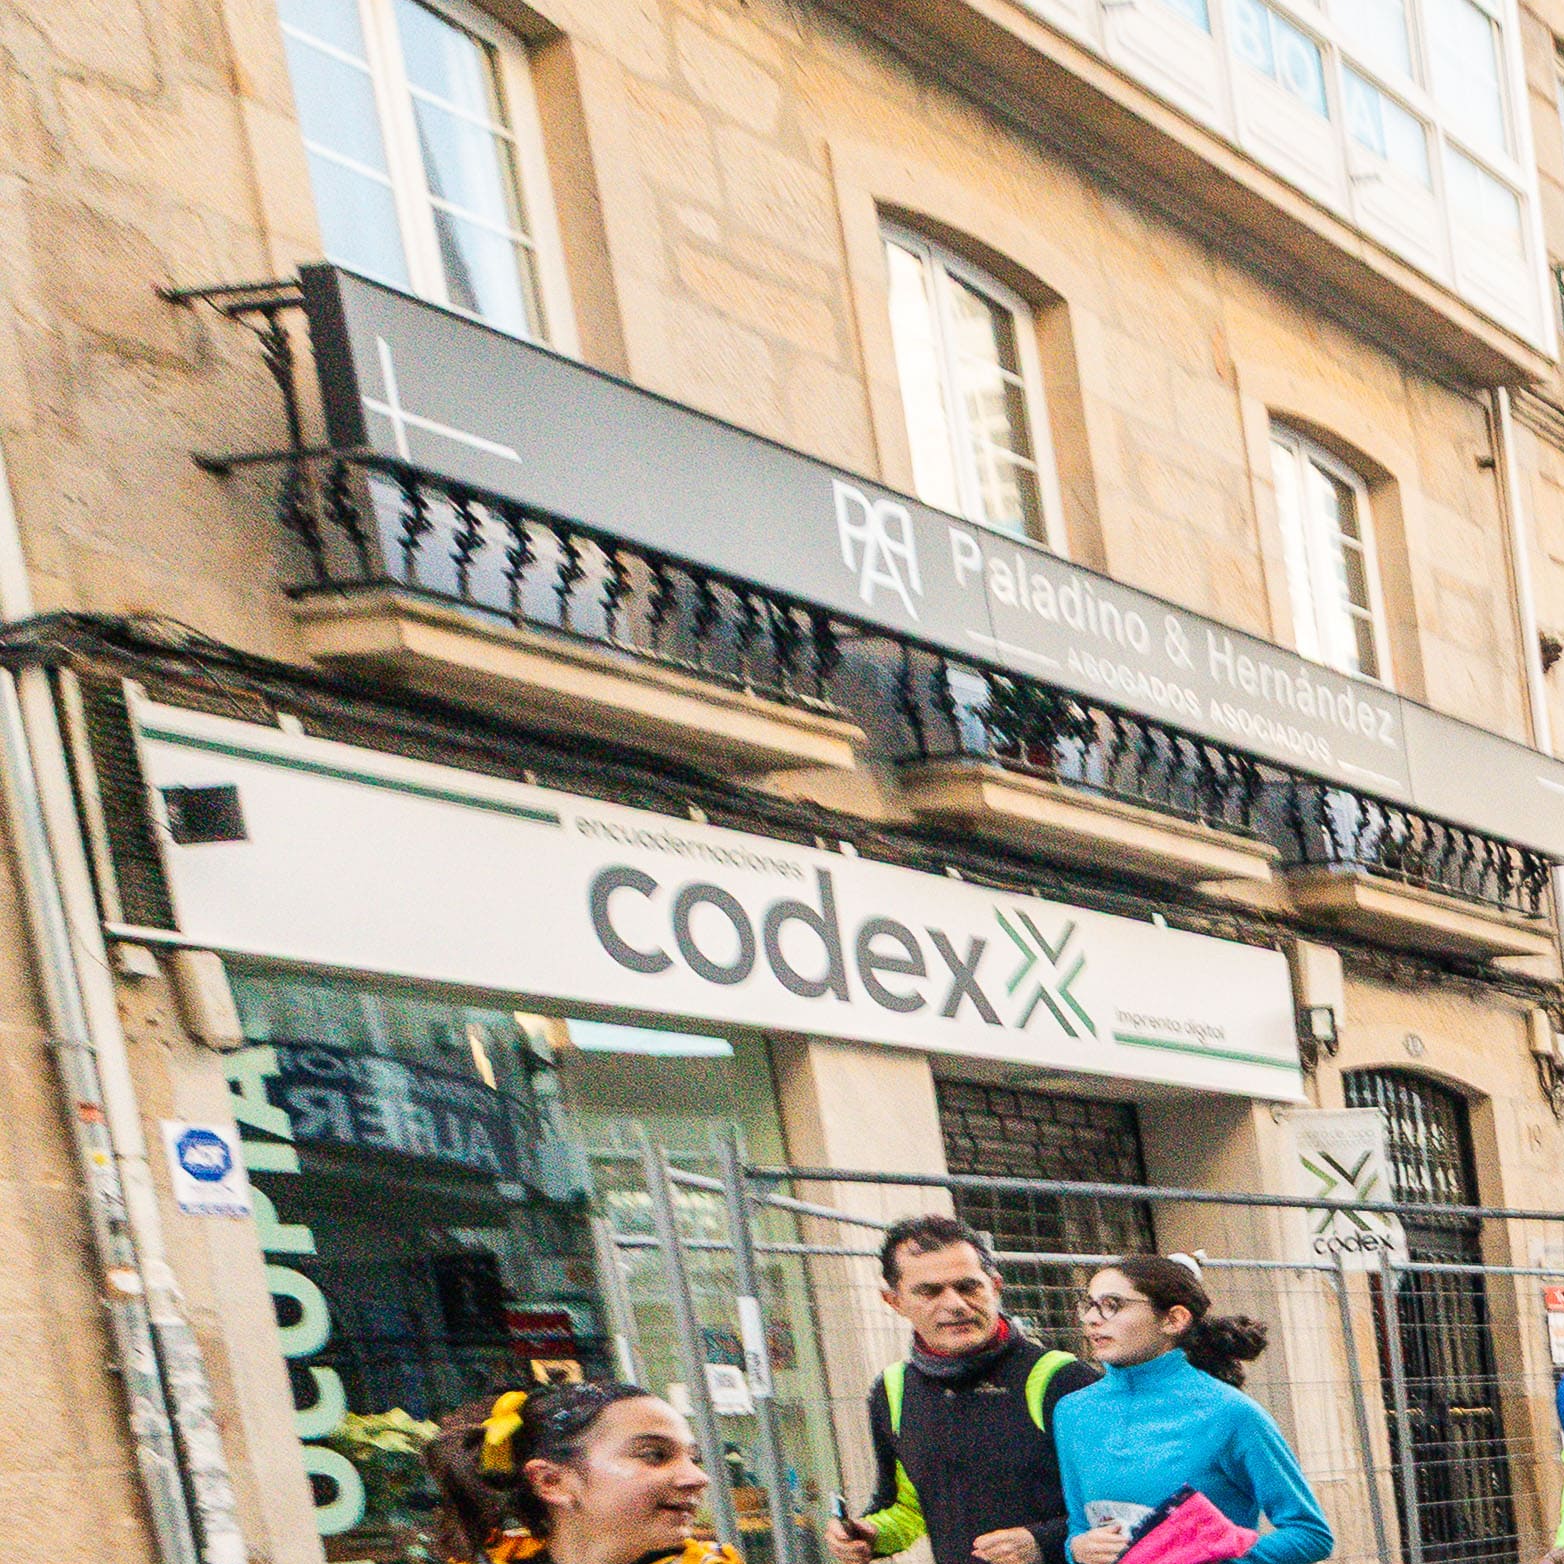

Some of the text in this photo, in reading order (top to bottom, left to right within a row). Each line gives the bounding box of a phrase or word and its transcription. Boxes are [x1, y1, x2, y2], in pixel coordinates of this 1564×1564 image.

[949, 527, 1398, 749] Paladino & Hernández
[1068, 646, 1334, 768] ABOGADOS ASOCIADOS
[574, 814, 805, 881] encuadernaciones
[588, 863, 1003, 1026] codex
[1115, 1007, 1226, 1047] imprenta digital
[1313, 1229, 1395, 1257] codex
